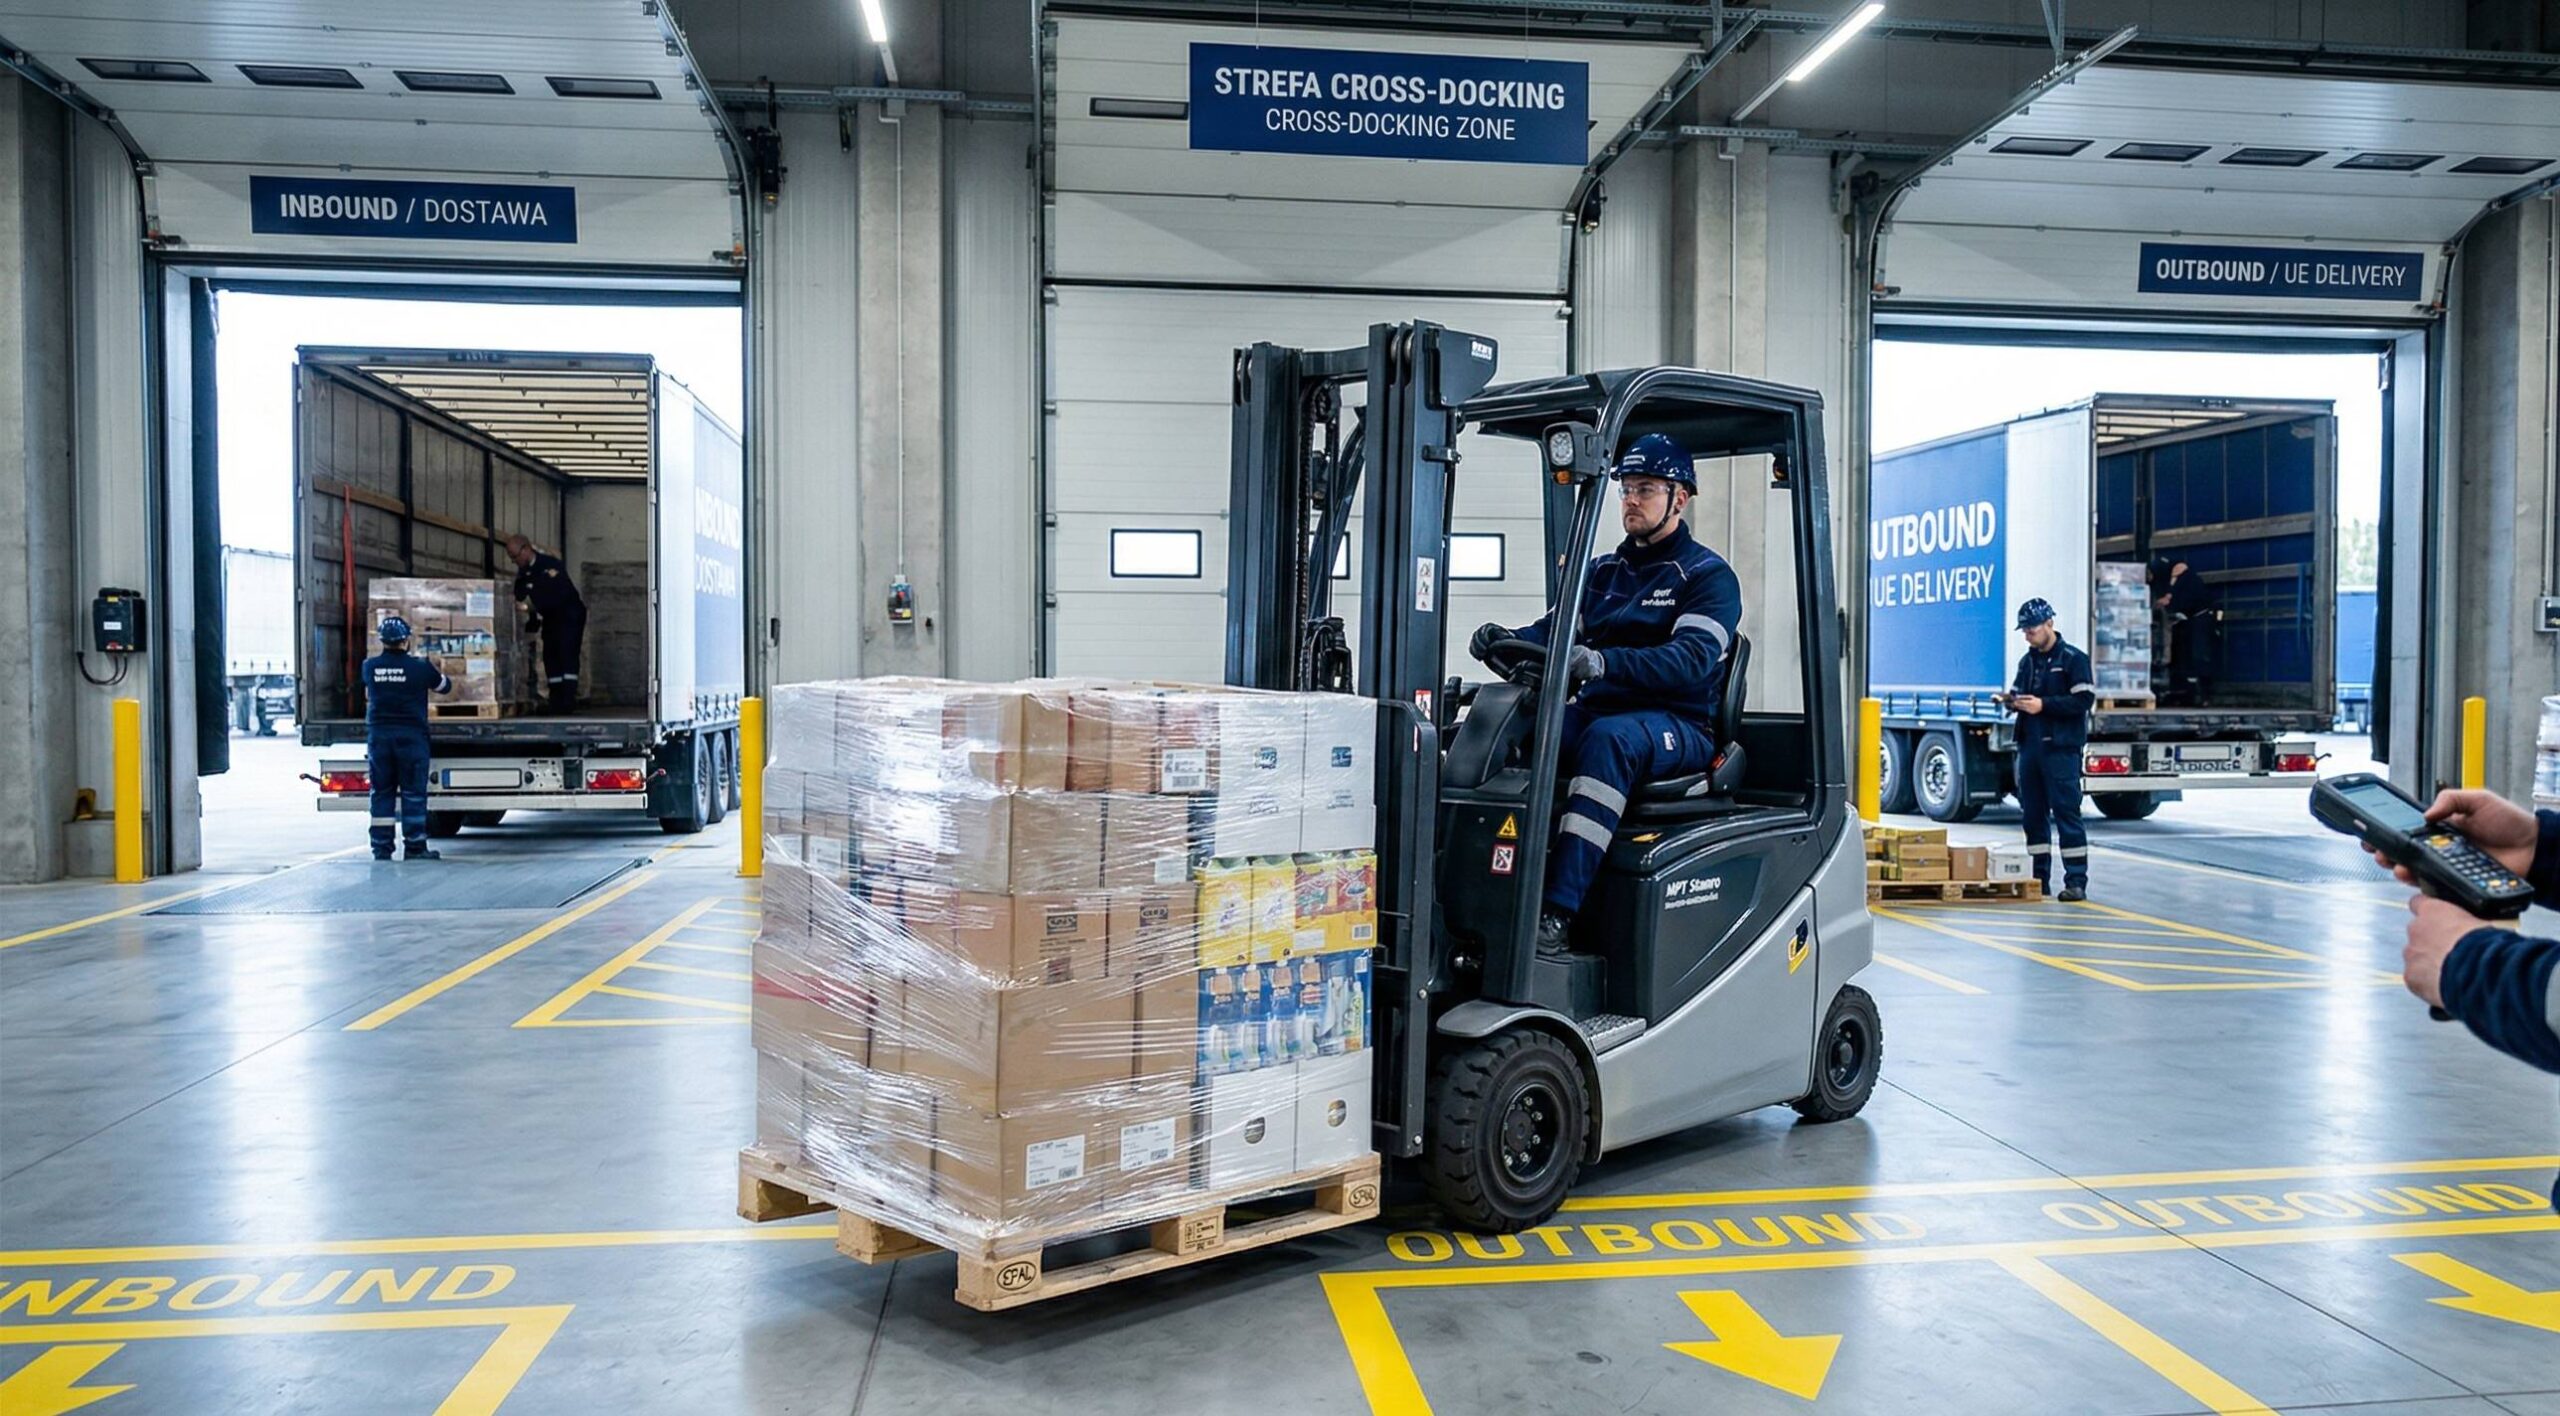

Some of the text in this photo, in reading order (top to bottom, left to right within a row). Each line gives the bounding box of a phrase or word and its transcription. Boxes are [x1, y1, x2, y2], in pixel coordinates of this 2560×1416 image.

[1214, 67, 1565, 110] STREFA CROSS-DOCKING
[1265, 108, 1516, 140] CROSS-DOCKING ZONE
[280, 193, 548, 226] INBOUND / DOSTAWA
[2156, 258, 2406, 287] OUTBOUND / UE DELIVERY
[1874, 564, 1994, 608] UE DELIVERY
[2040, 1183, 2552, 1233] OUTBOUND
[1384, 1211, 1928, 1263] OUTBOUND
